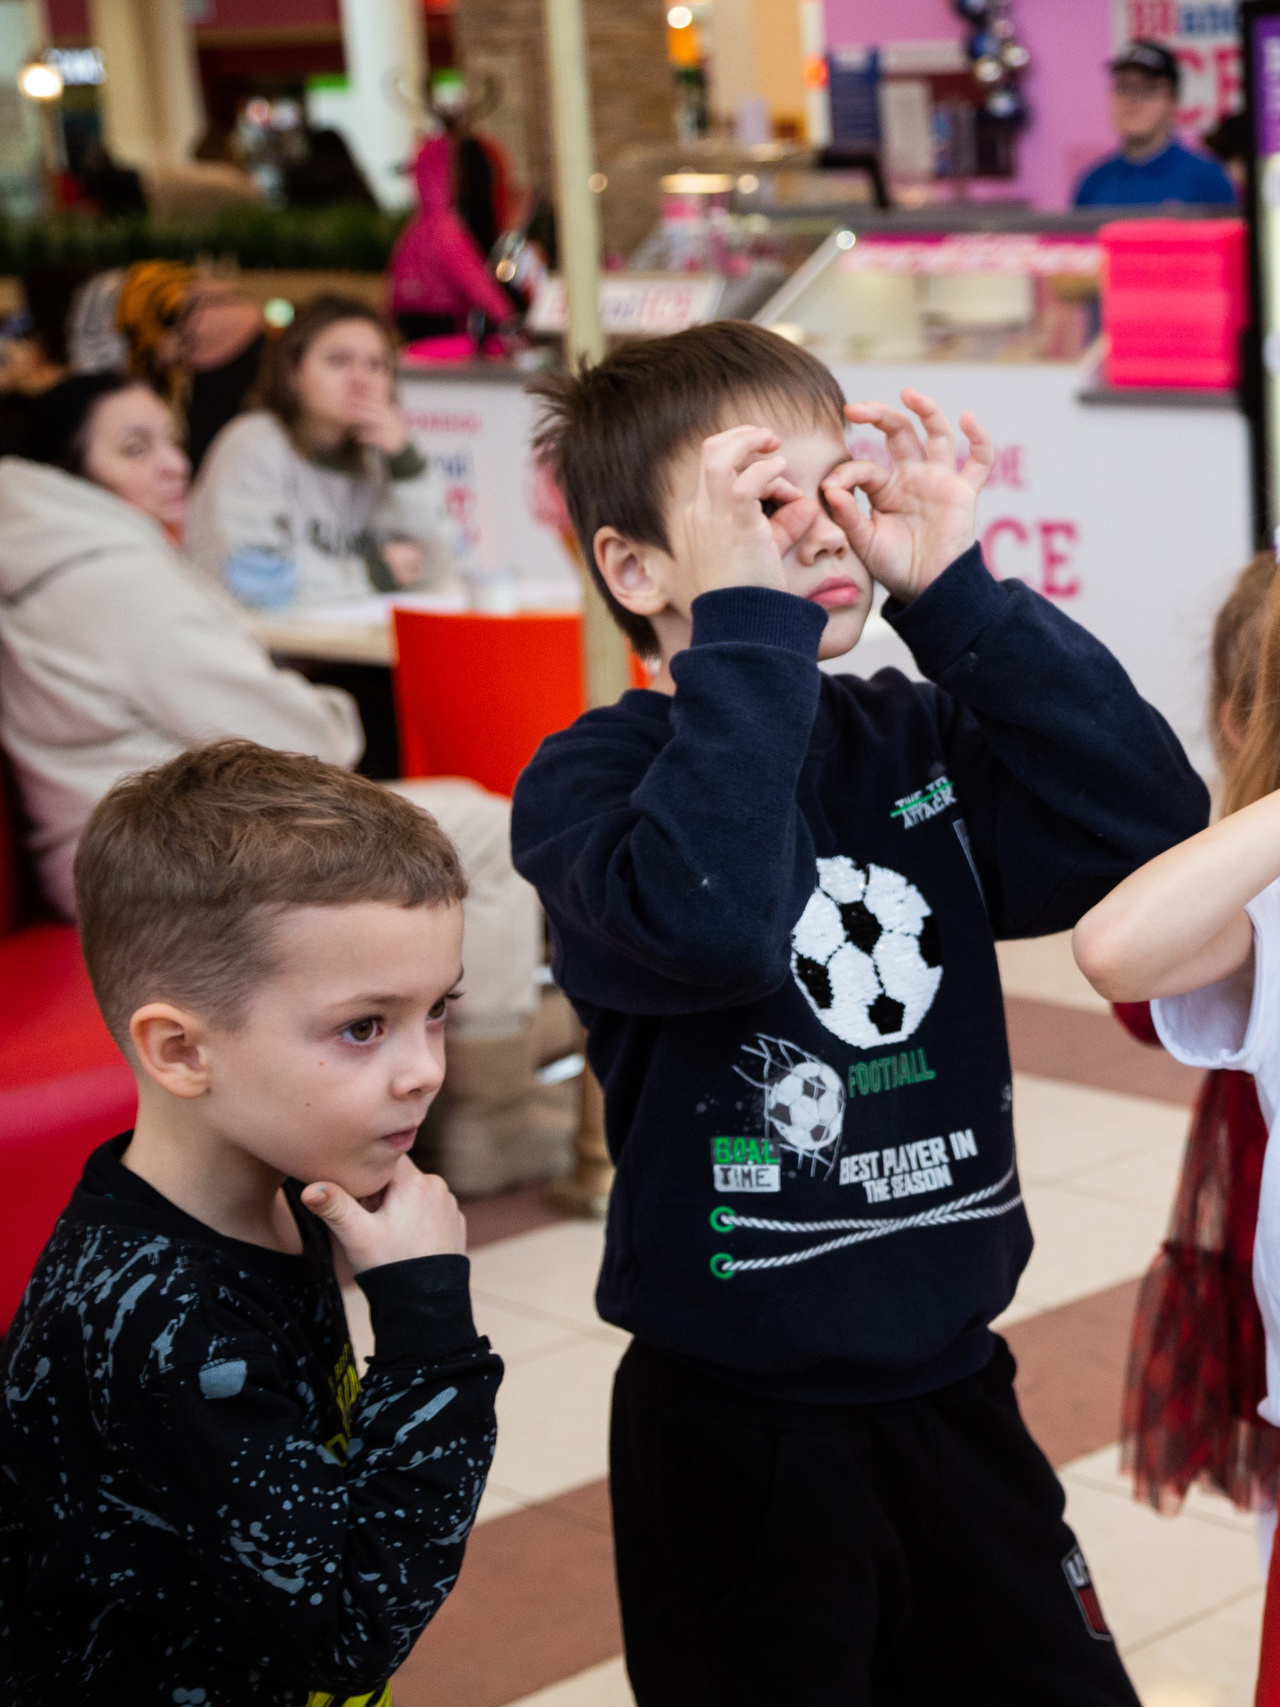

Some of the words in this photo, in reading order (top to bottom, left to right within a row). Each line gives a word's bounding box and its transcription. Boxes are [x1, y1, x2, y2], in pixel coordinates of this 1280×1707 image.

[839, 1151, 880, 1185] BEST
[881, 1136, 951, 1177] PLAYER
[949, 1128, 979, 1160] IN
[720, 1167, 771, 1188] TIME
[862, 1176, 892, 1204] THE
[891, 1164, 953, 1199] SEASON
